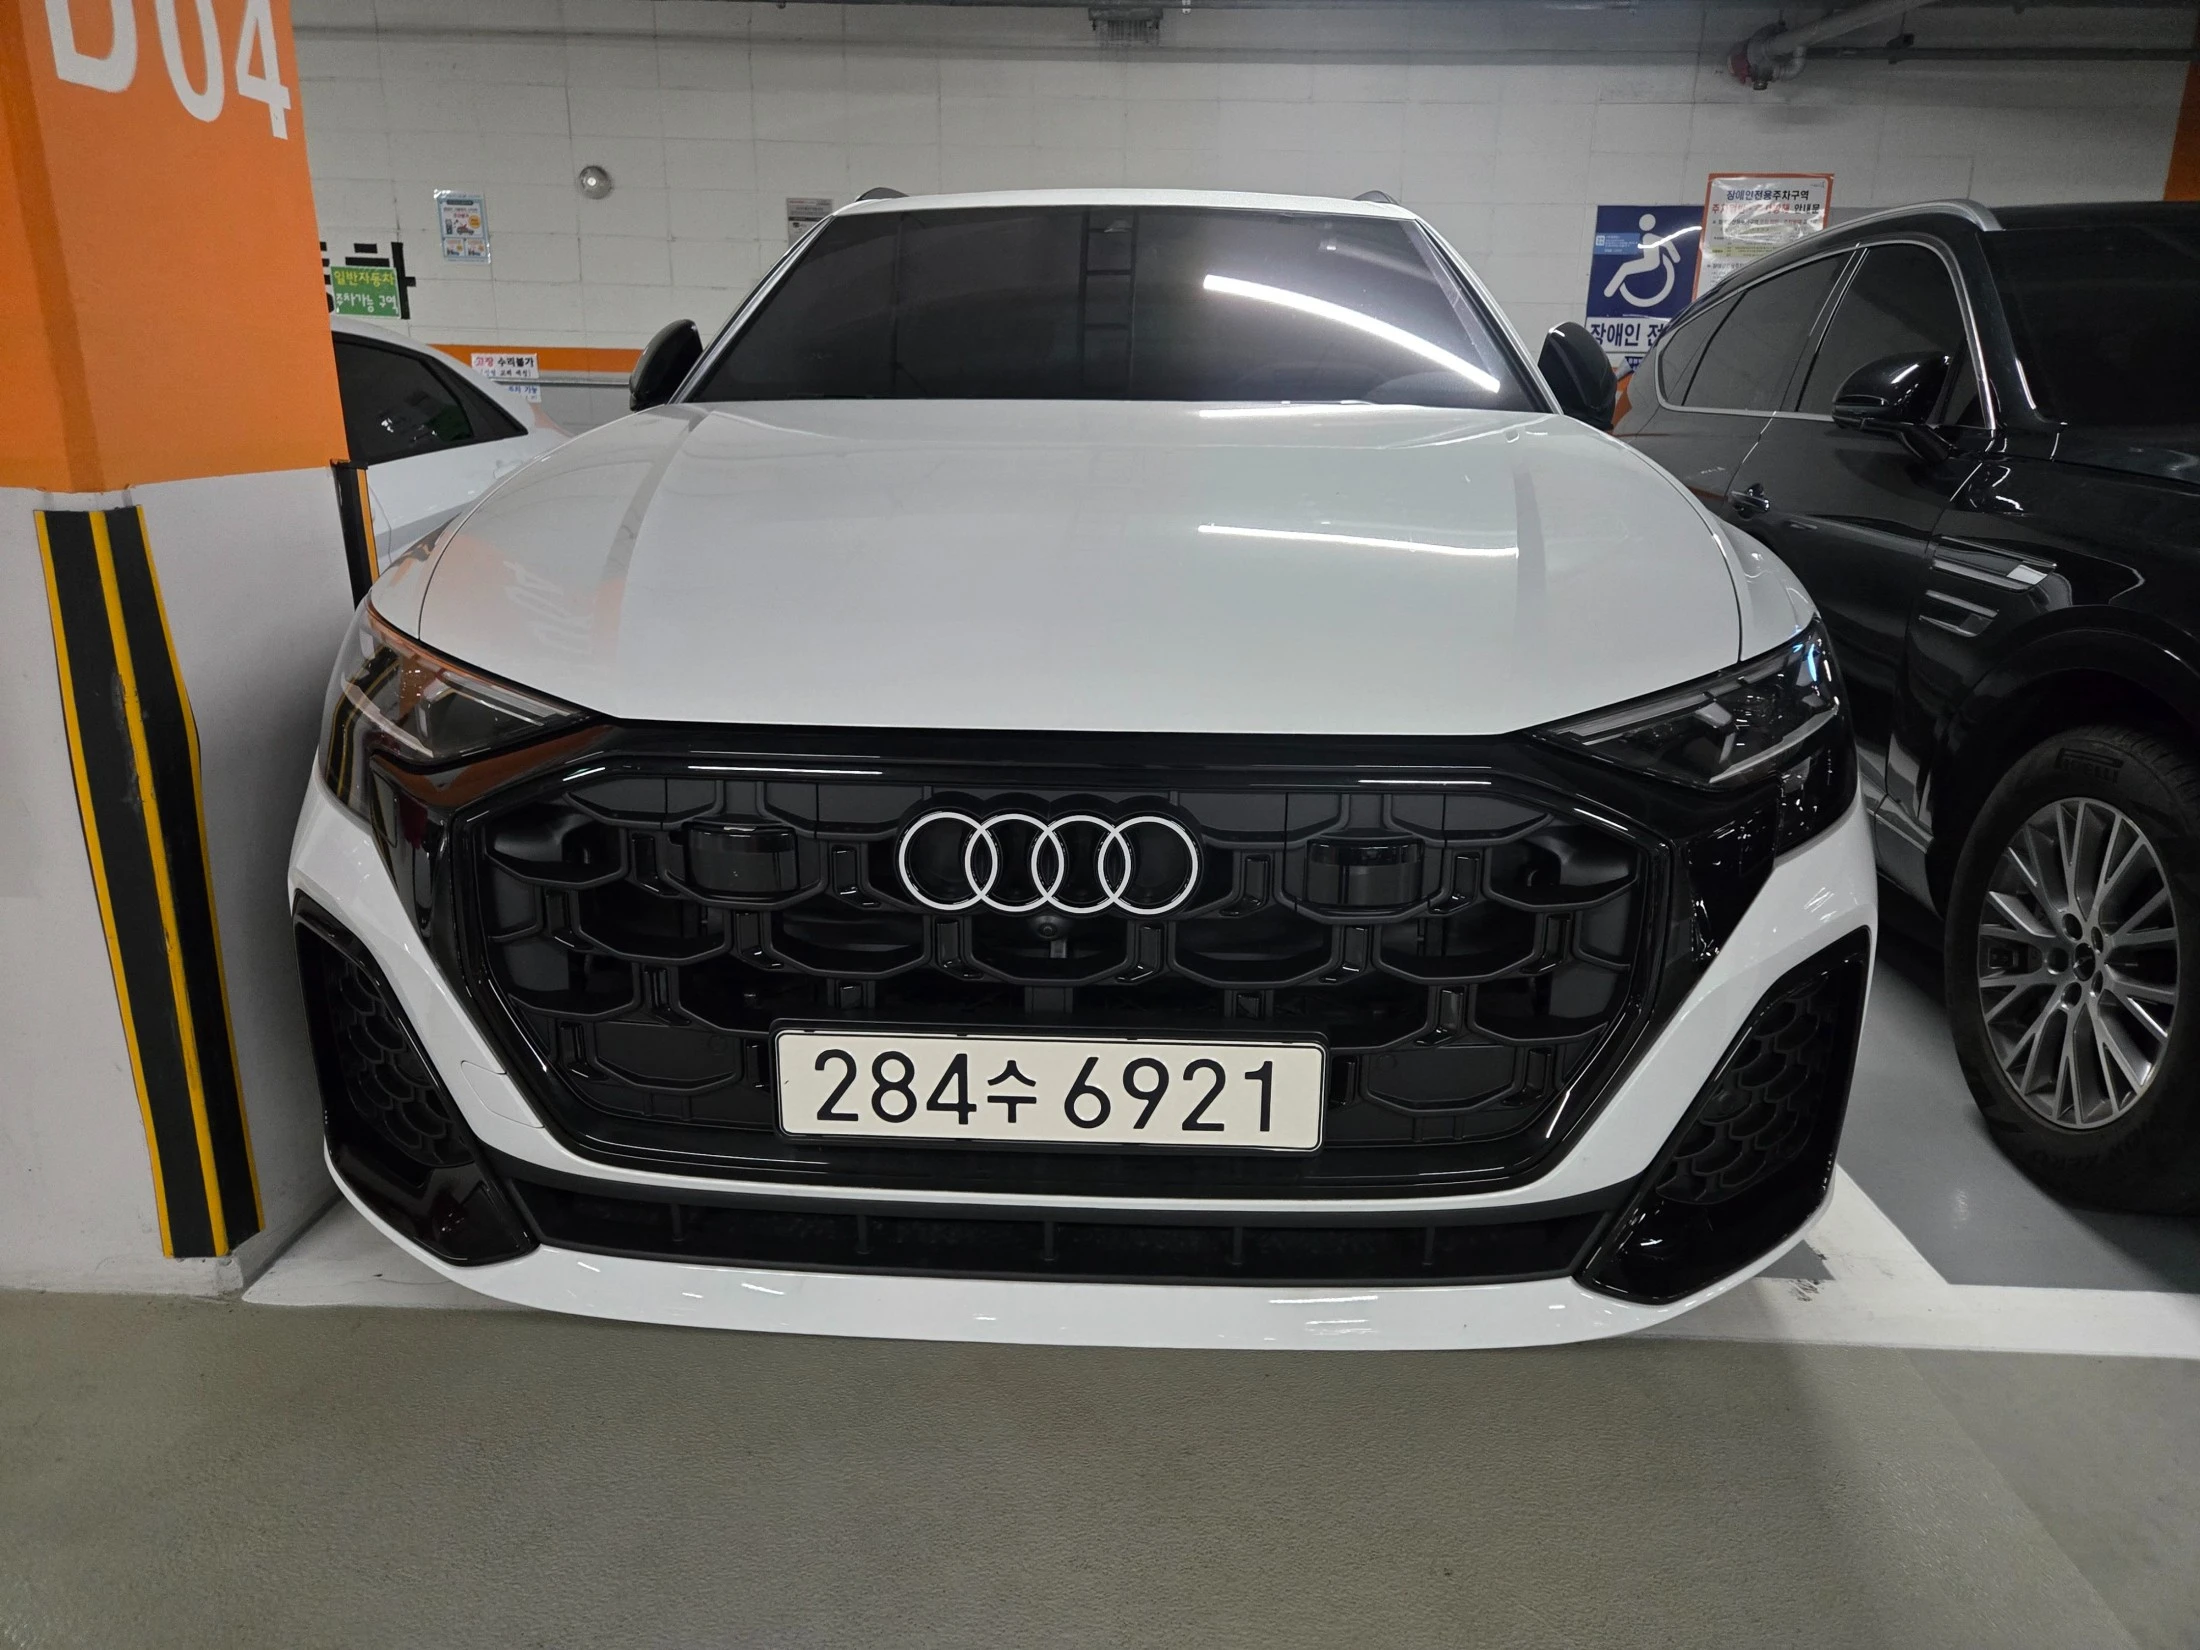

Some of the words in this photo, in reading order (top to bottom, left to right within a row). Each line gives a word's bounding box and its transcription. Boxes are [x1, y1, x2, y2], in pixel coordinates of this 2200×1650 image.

[1726, 189, 1810, 201] 장애인전용주차구역
[333, 270, 395, 288] 일반자동차
[378, 294, 399, 315] 구역
[813, 1048, 1038, 1126] 284수
[1063, 1056, 1274, 1133] 6921
